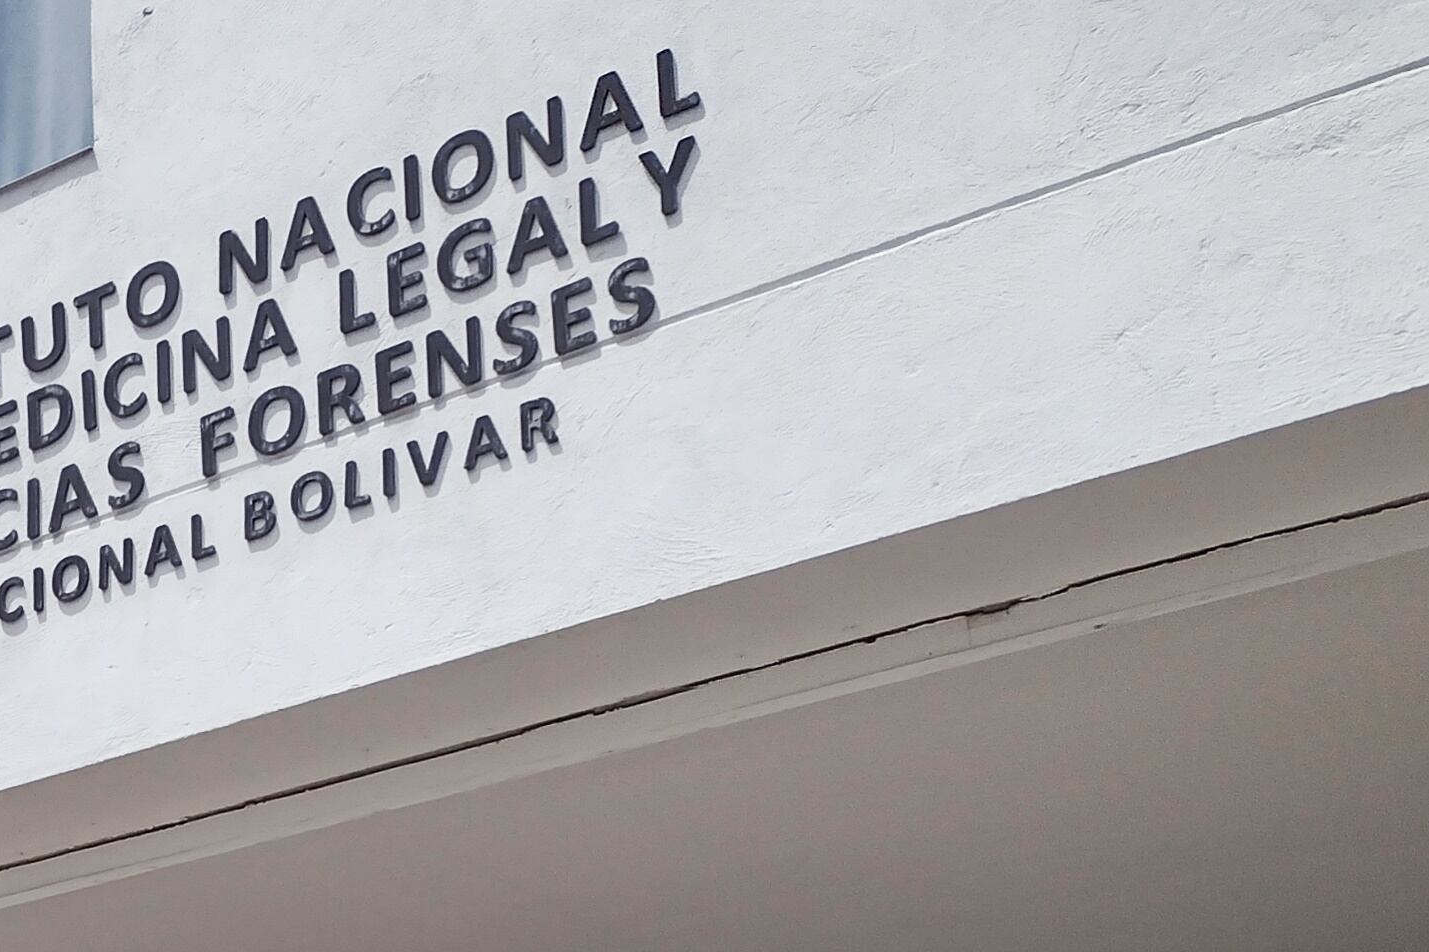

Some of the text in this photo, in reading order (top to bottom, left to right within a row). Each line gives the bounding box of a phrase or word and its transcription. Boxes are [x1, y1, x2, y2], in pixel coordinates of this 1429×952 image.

[217, 47, 704, 299] NACIONAL
[337, 176, 624, 338] LEGAL
[637, 134, 699, 219] Y
[198, 256, 658, 480] FORENSES
[243, 396, 560, 545] BOLIVAR
